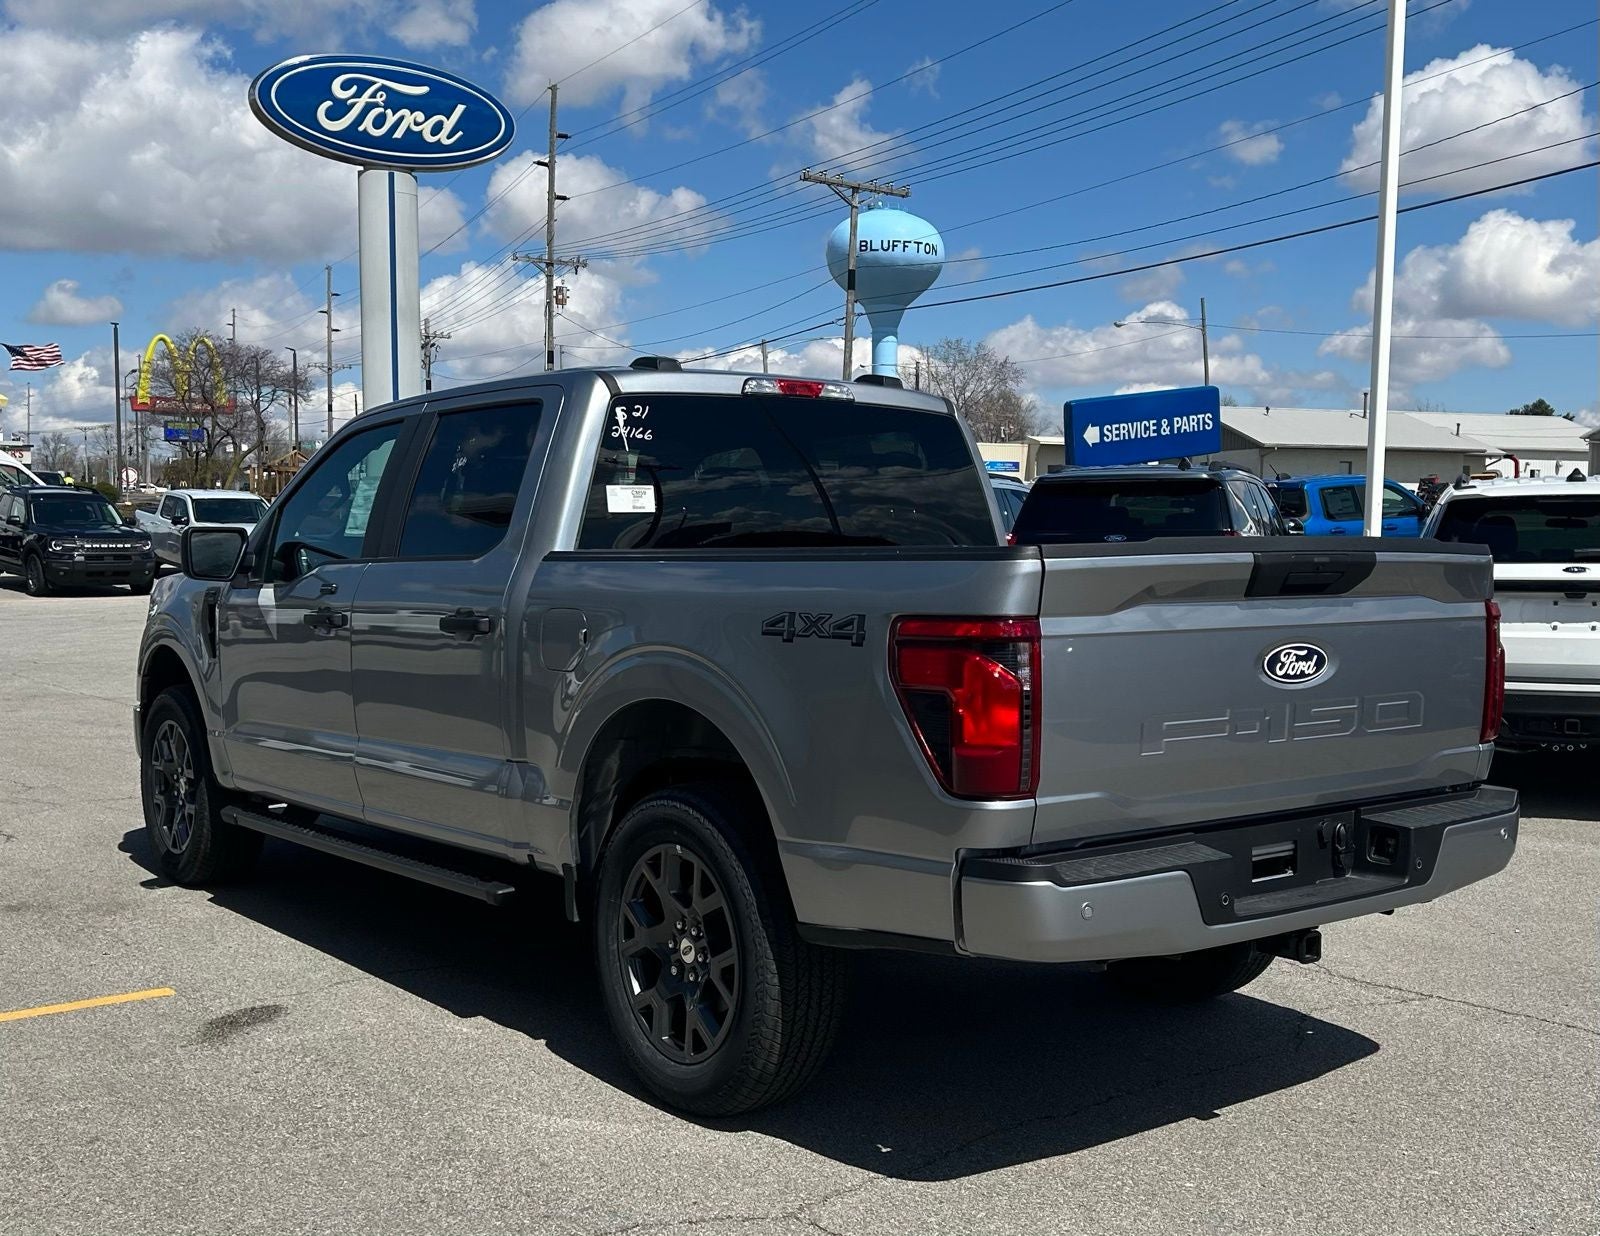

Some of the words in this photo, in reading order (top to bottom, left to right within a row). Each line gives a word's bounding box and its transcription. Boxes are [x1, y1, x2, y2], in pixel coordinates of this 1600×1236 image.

[316, 73, 467, 146] Ford
[859, 239, 938, 256] BLUFFTON
[1103, 419, 1158, 443] SERVICE
[1160, 418, 1171, 436] &
[1173, 412, 1214, 434] PARTS
[1275, 649, 1317, 676] Ford
[1140, 690, 1424, 757] F-150
